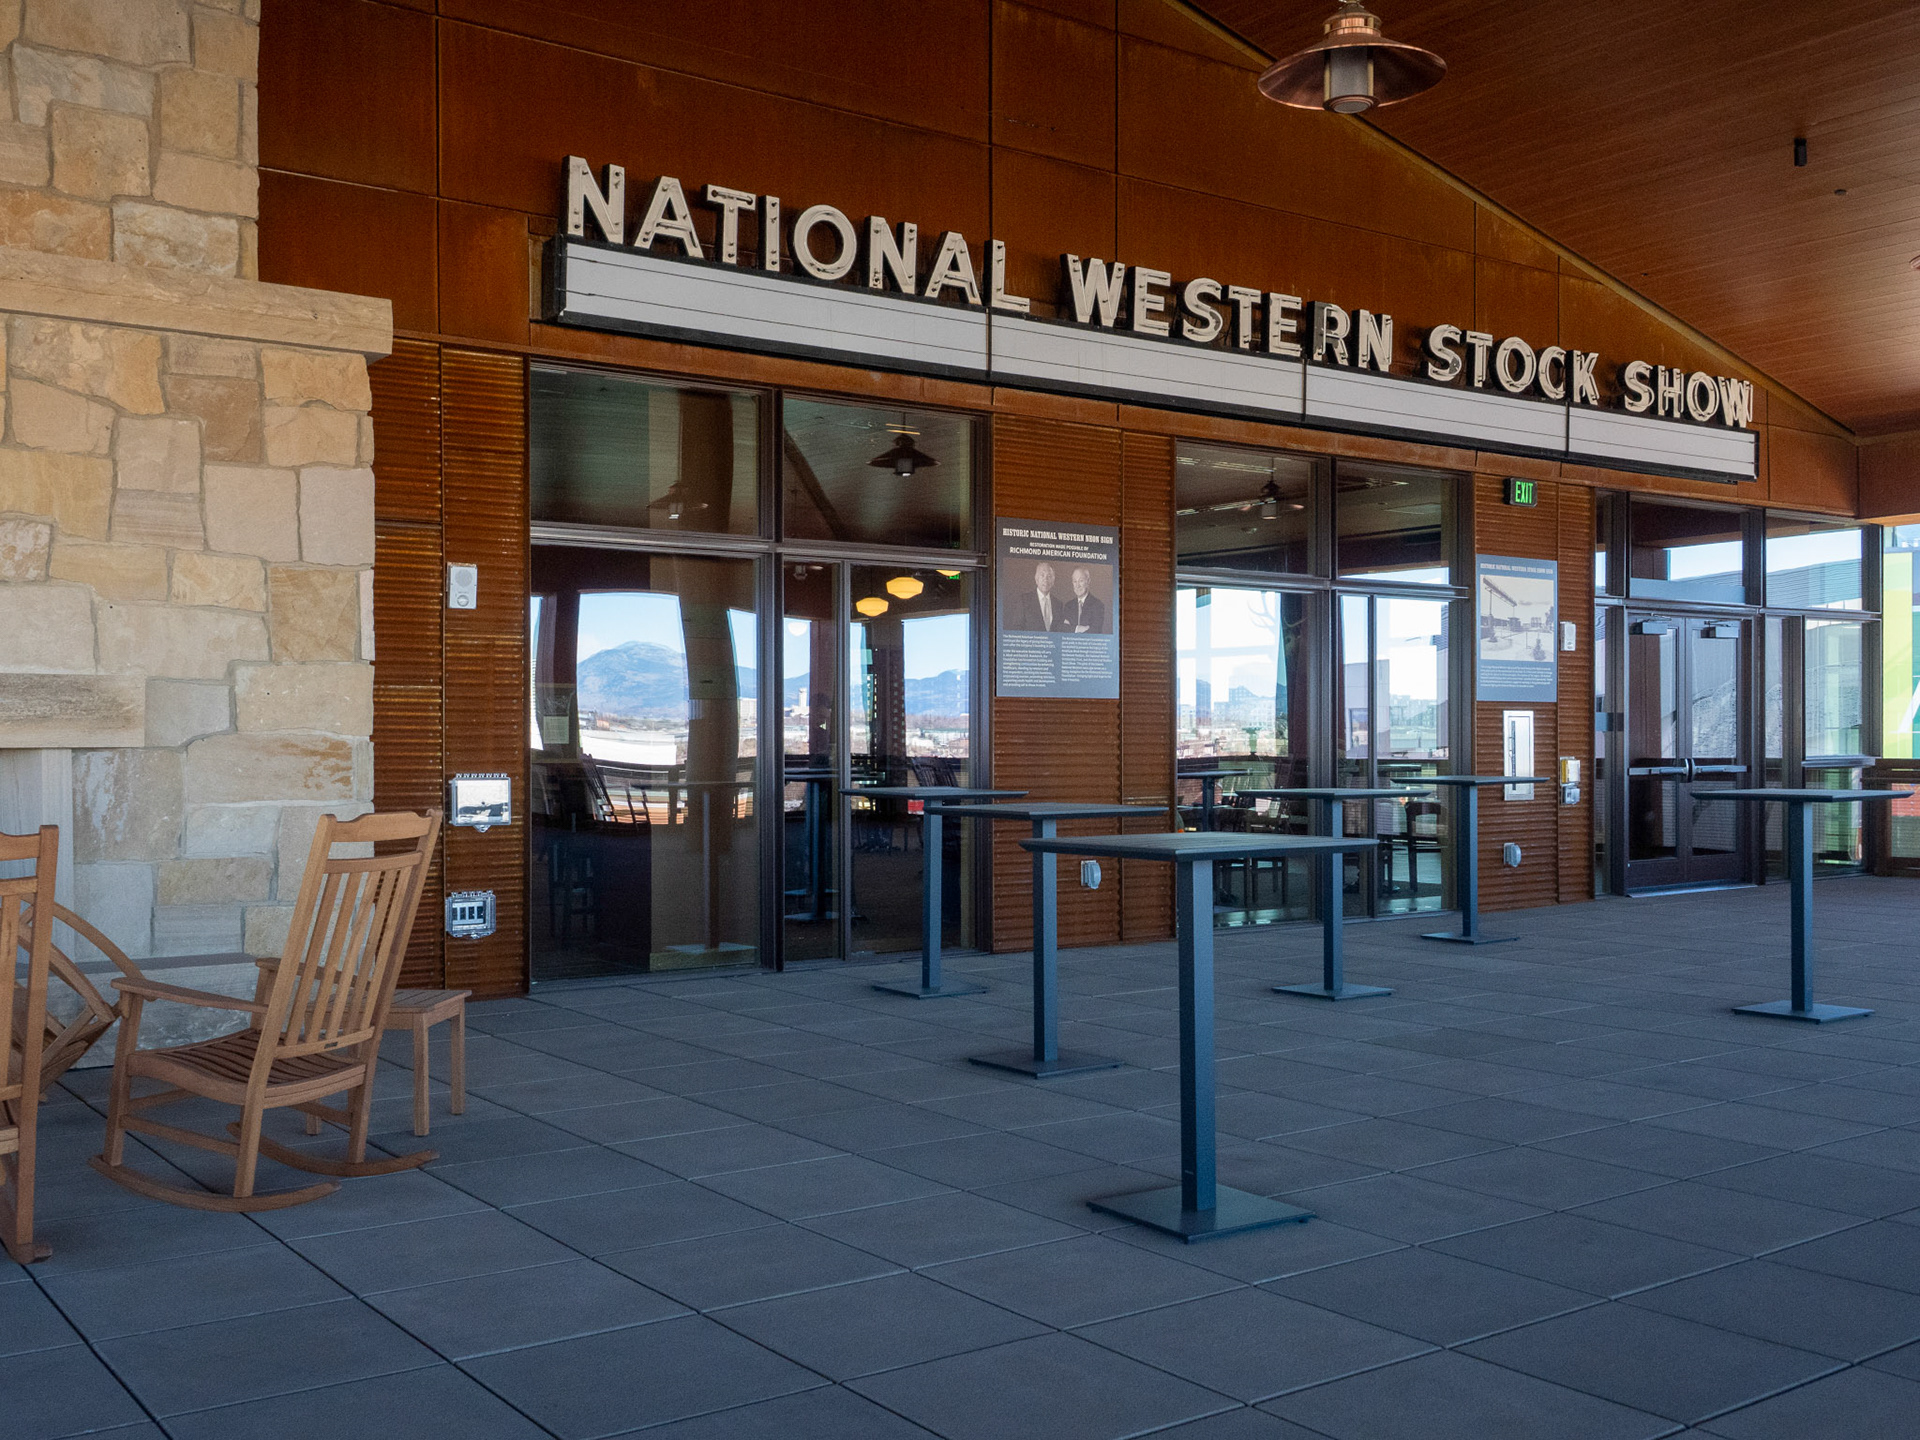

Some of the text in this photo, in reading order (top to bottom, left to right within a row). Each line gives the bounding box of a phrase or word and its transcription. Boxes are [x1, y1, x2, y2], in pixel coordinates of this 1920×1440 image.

[566, 154, 1754, 429] NATIONAL WESTERN STOCK SHOW
[1515, 481, 1534, 504] EXIT
[1002, 528, 1029, 538] HISTORIC
[1030, 530, 1057, 540] NATIONAL
[1058, 532, 1084, 542] WESTERN
[1100, 536, 1114, 544] SIGN
[1010, 546, 1107, 560] RICHMOND AMERICAN FOUNDATION
